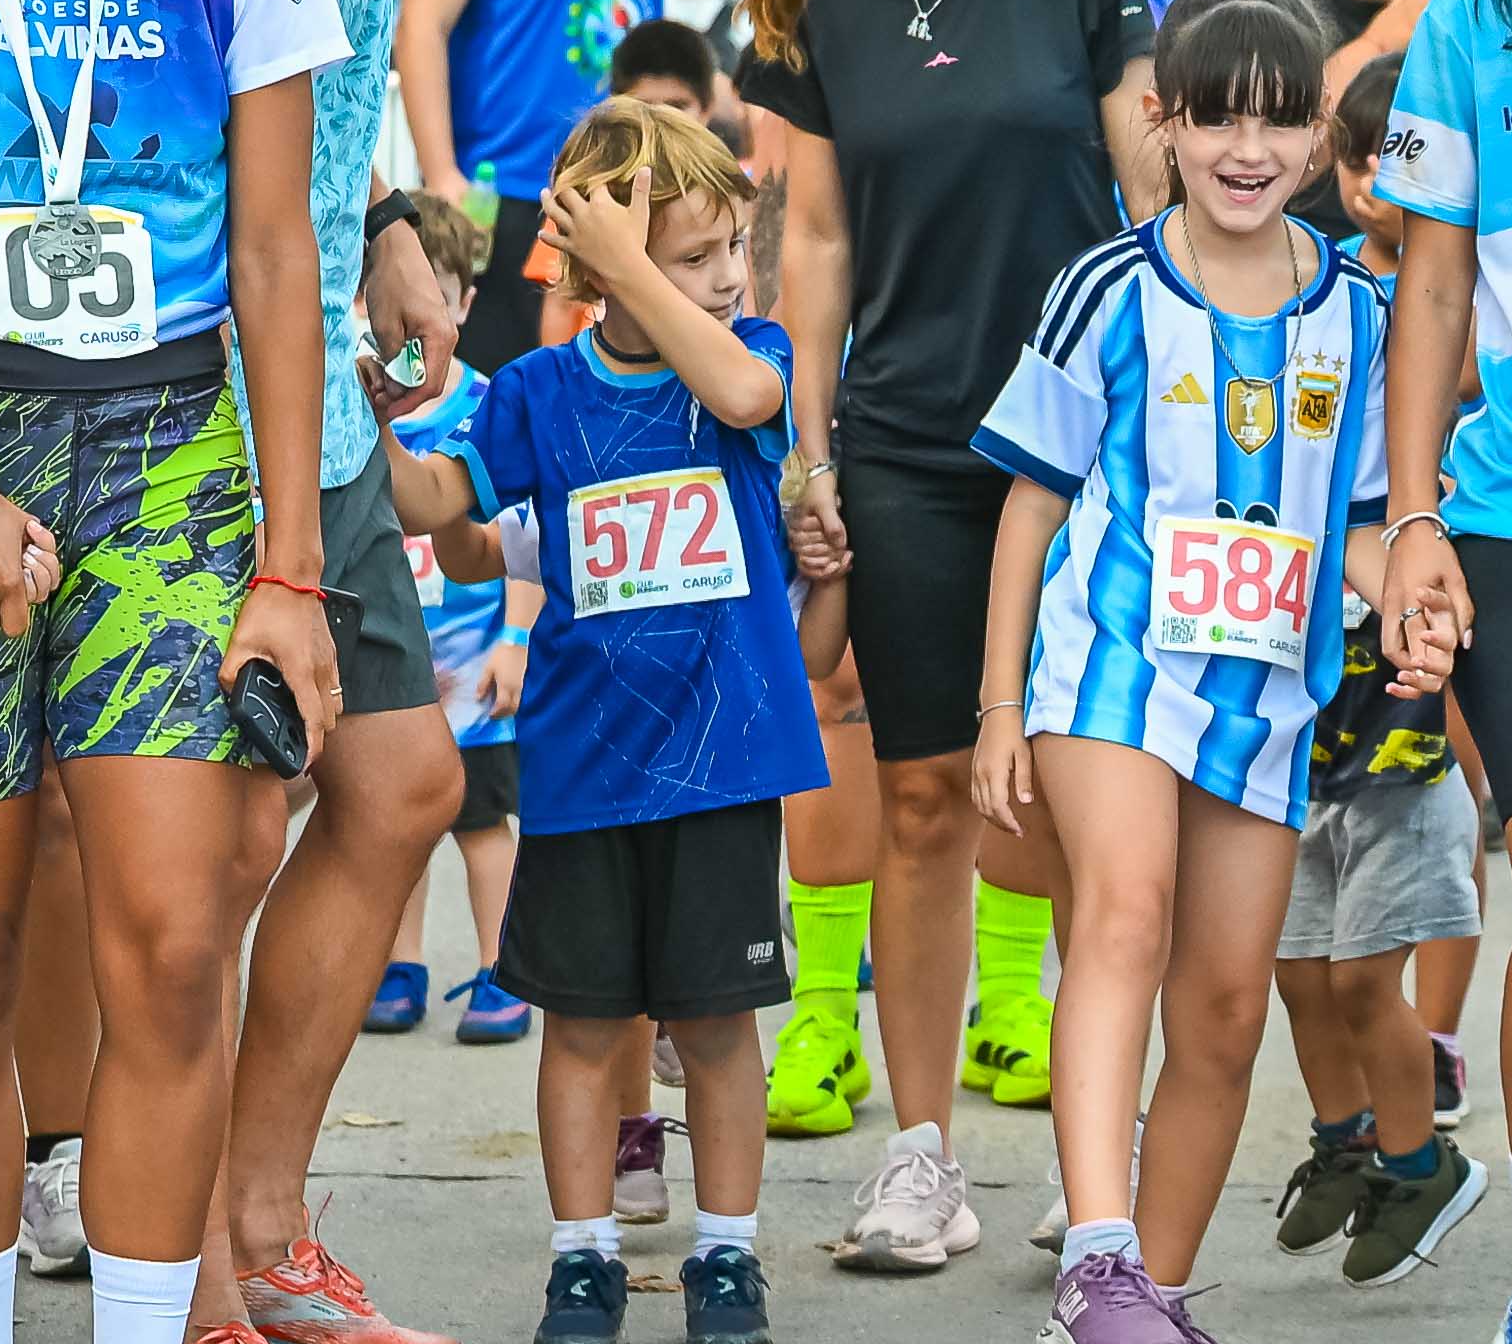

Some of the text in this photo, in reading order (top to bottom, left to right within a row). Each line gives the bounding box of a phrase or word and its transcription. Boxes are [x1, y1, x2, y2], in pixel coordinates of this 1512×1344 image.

[104, 0, 140, 18] DE
[79, 331, 139, 344] CARUSO
[582, 482, 728, 579] 572
[682, 574, 733, 590] CARUSO
[1168, 530, 1309, 634] 584
[747, 941, 775, 961] URB
